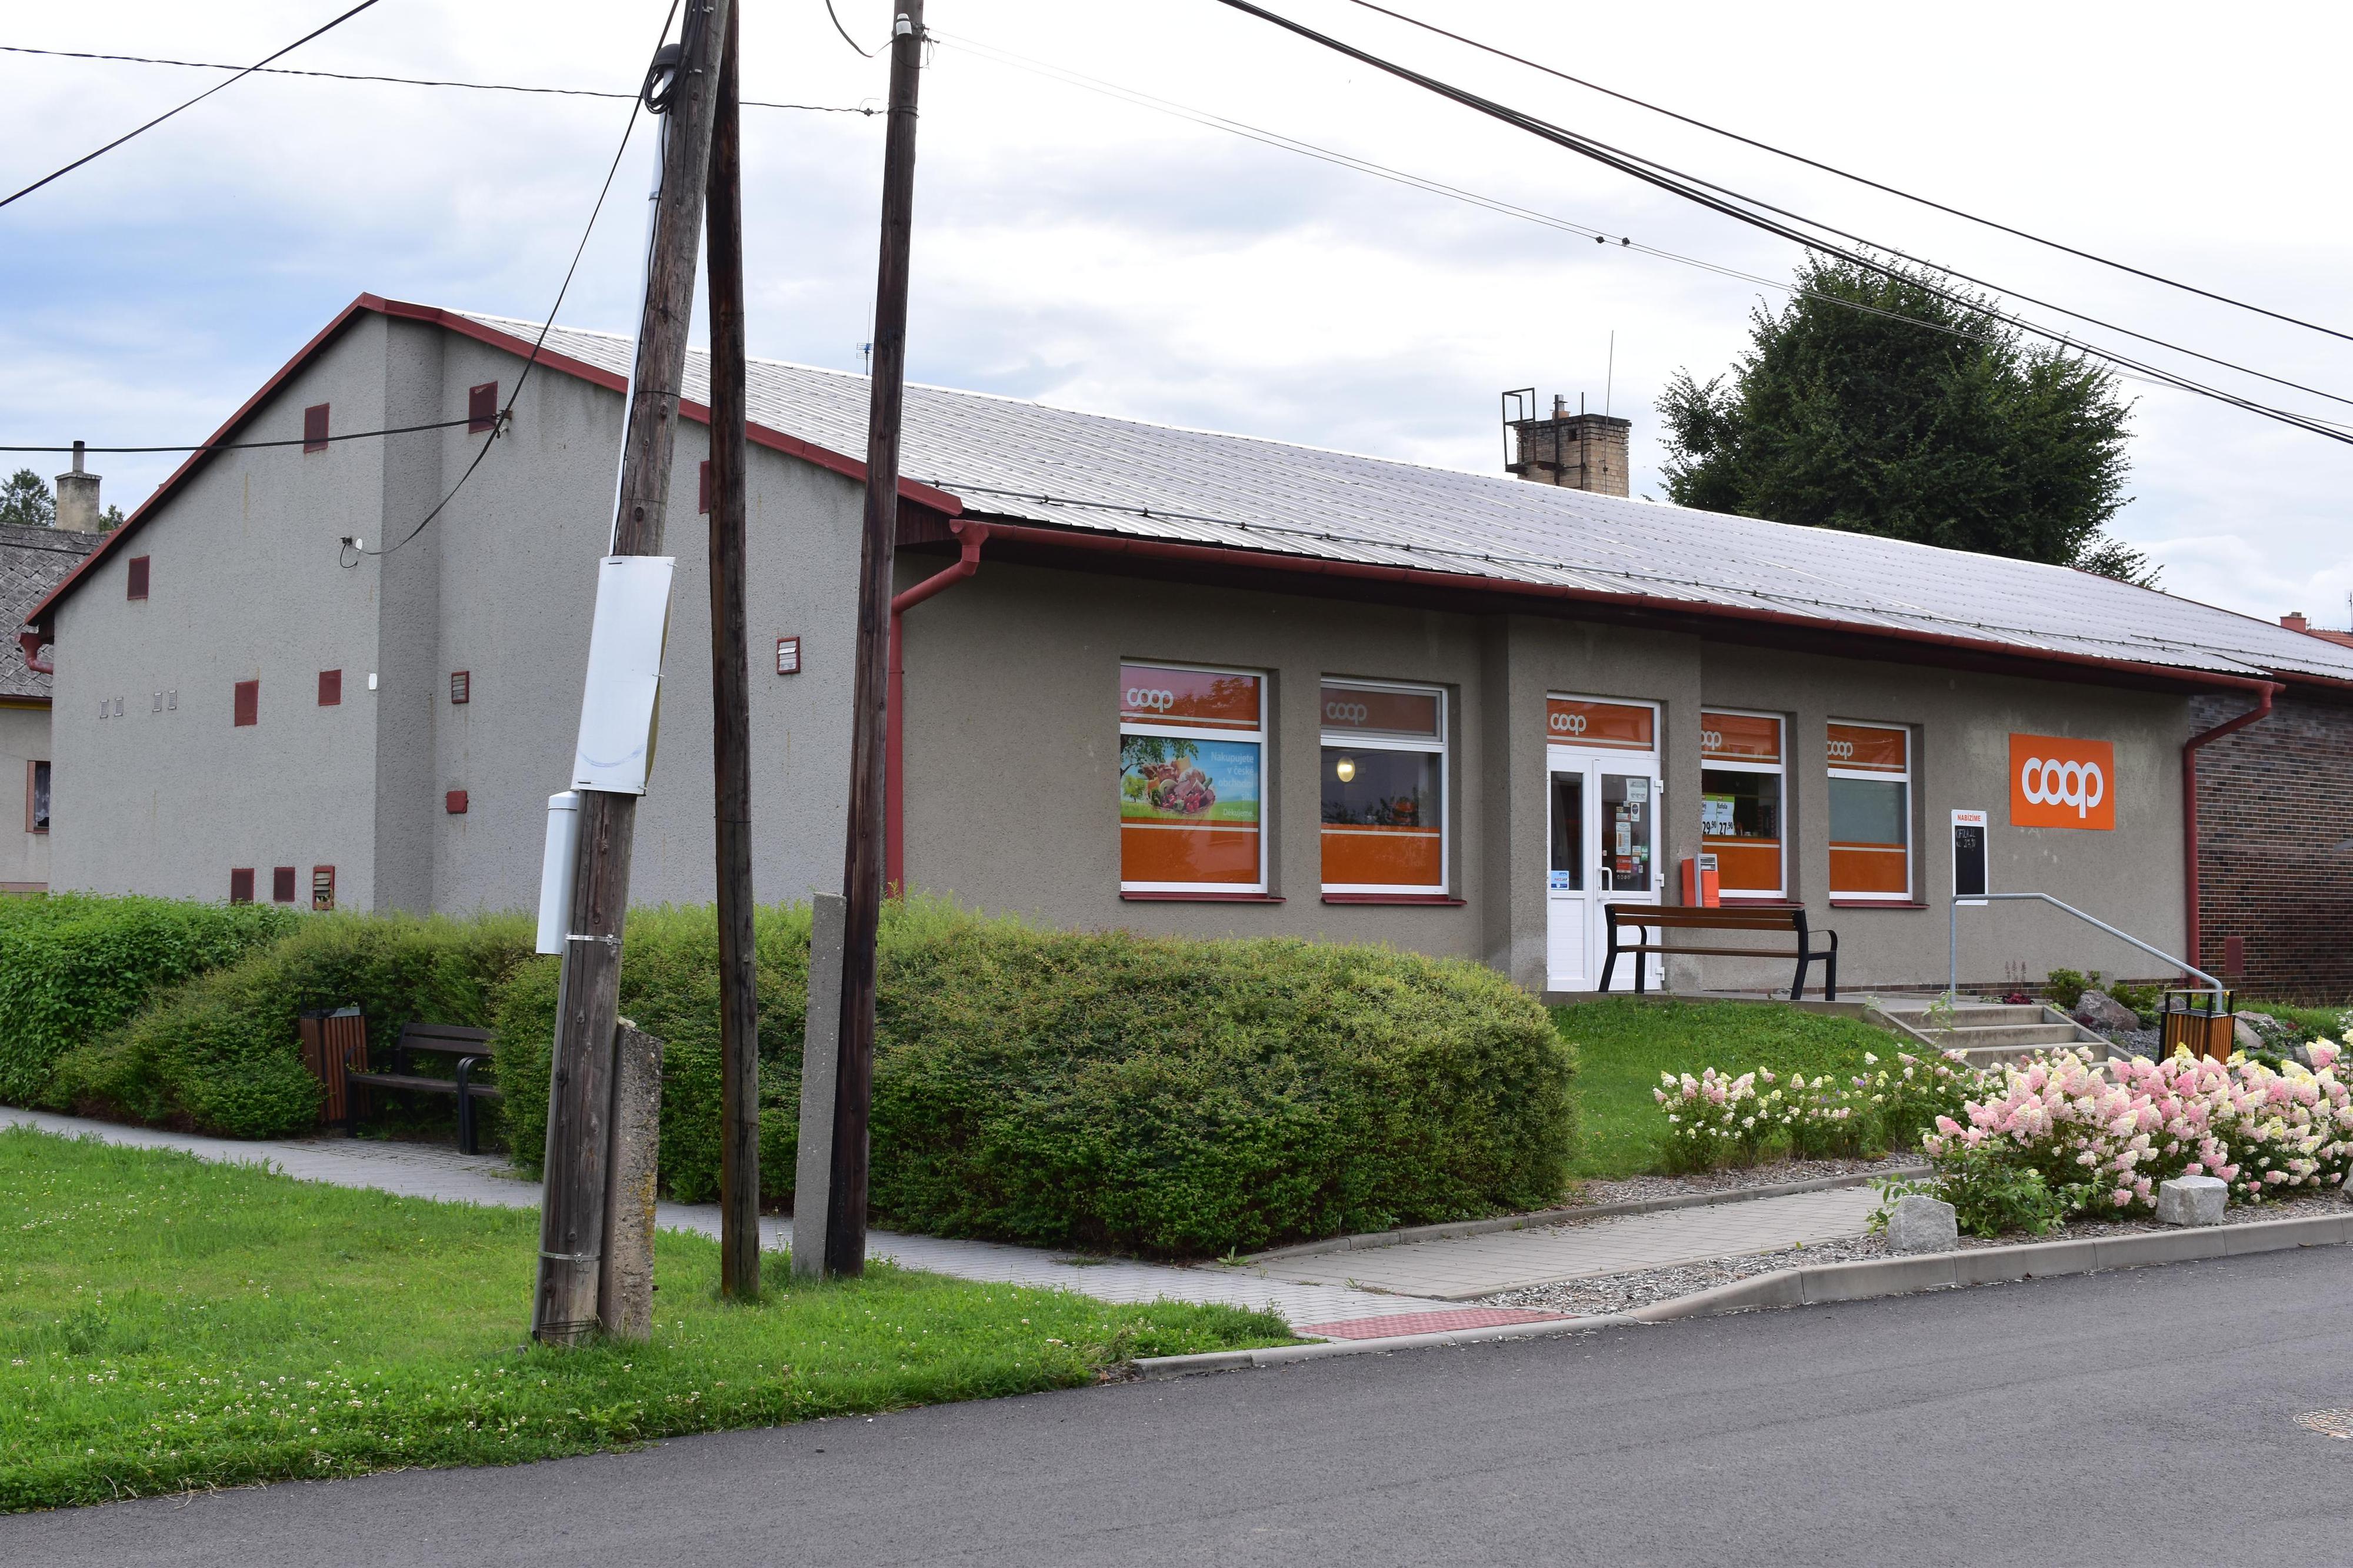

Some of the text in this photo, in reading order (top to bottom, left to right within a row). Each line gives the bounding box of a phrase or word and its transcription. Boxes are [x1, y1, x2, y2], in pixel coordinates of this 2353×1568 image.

[1126, 688, 1174, 713] coop
[1327, 702, 1367, 725] coop
[1551, 713, 1587, 735] coop
[1701, 730, 1722, 750] oop
[1827, 740, 1853, 760] coop
[1211, 752, 1254, 764] Nakupujete
[1234, 766, 1254, 775] české
[2022, 757, 2104, 818] coop
